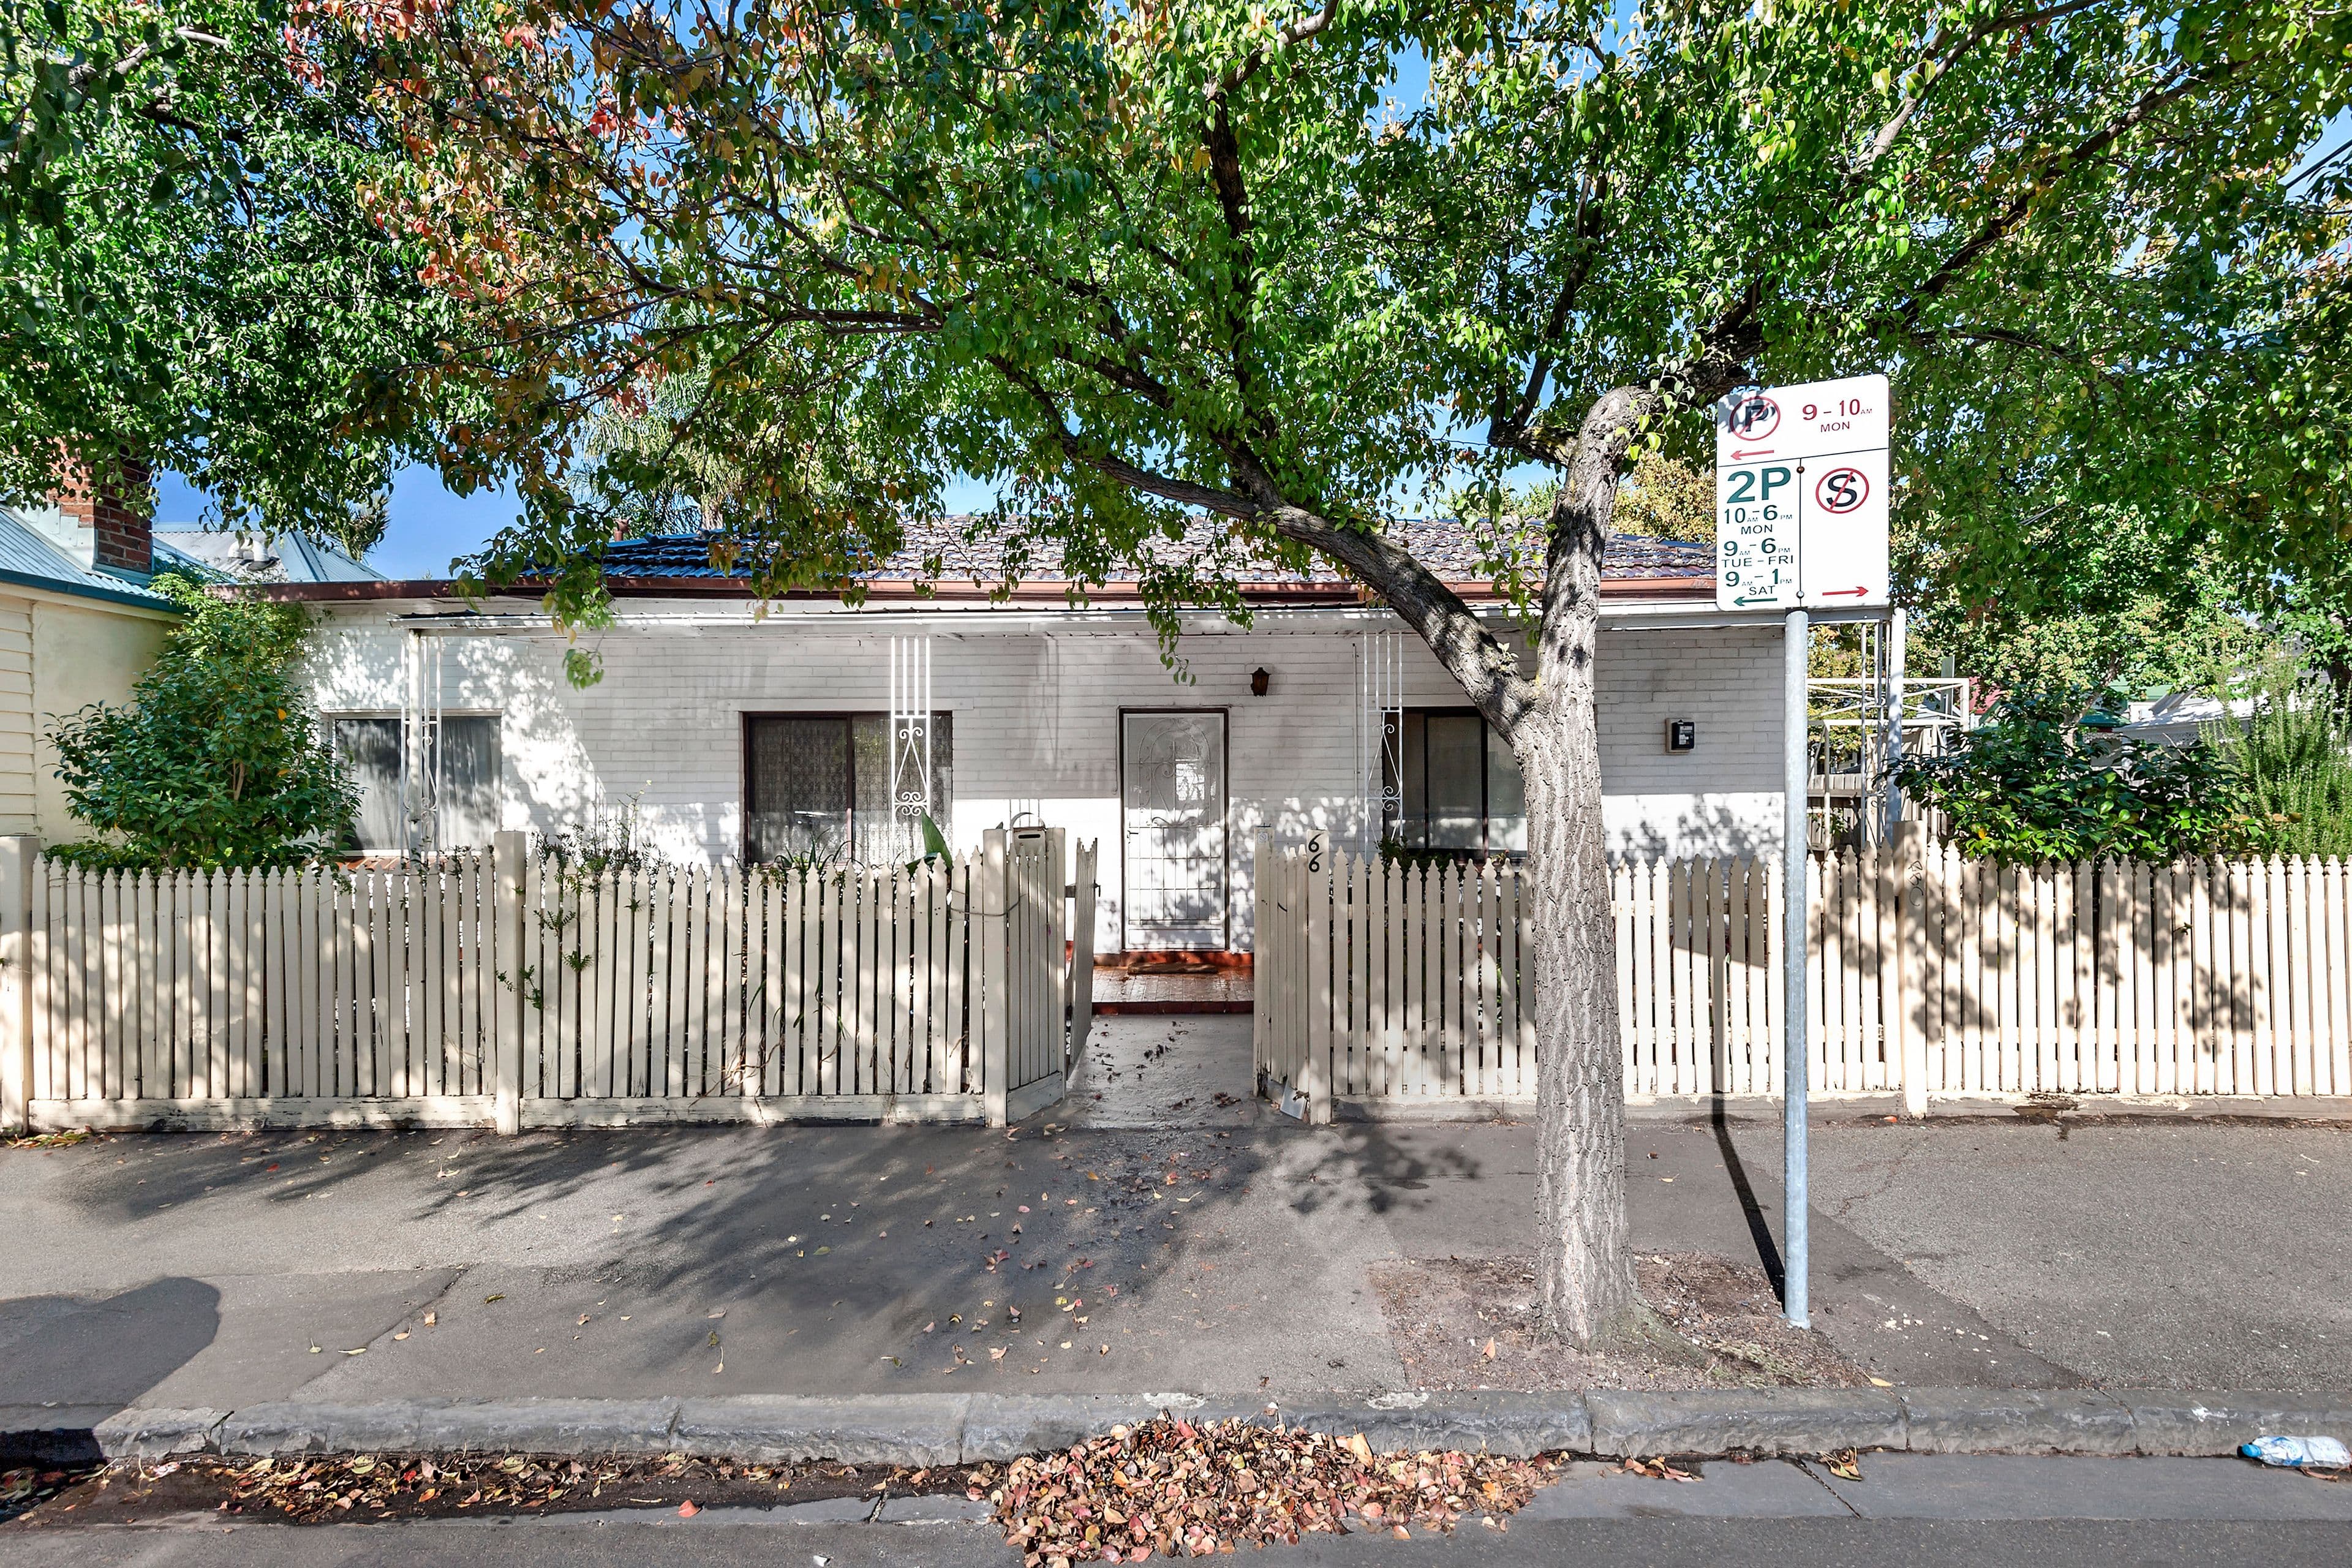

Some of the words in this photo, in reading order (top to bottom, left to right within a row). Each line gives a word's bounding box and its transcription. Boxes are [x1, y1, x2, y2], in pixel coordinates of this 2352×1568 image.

[1820, 421, 1850, 432] MON
[1727, 467, 1792, 503] 2P
[1826, 474, 1858, 507] S
[1741, 524, 1773, 535] MON
[1749, 585, 1776, 595] SAT
